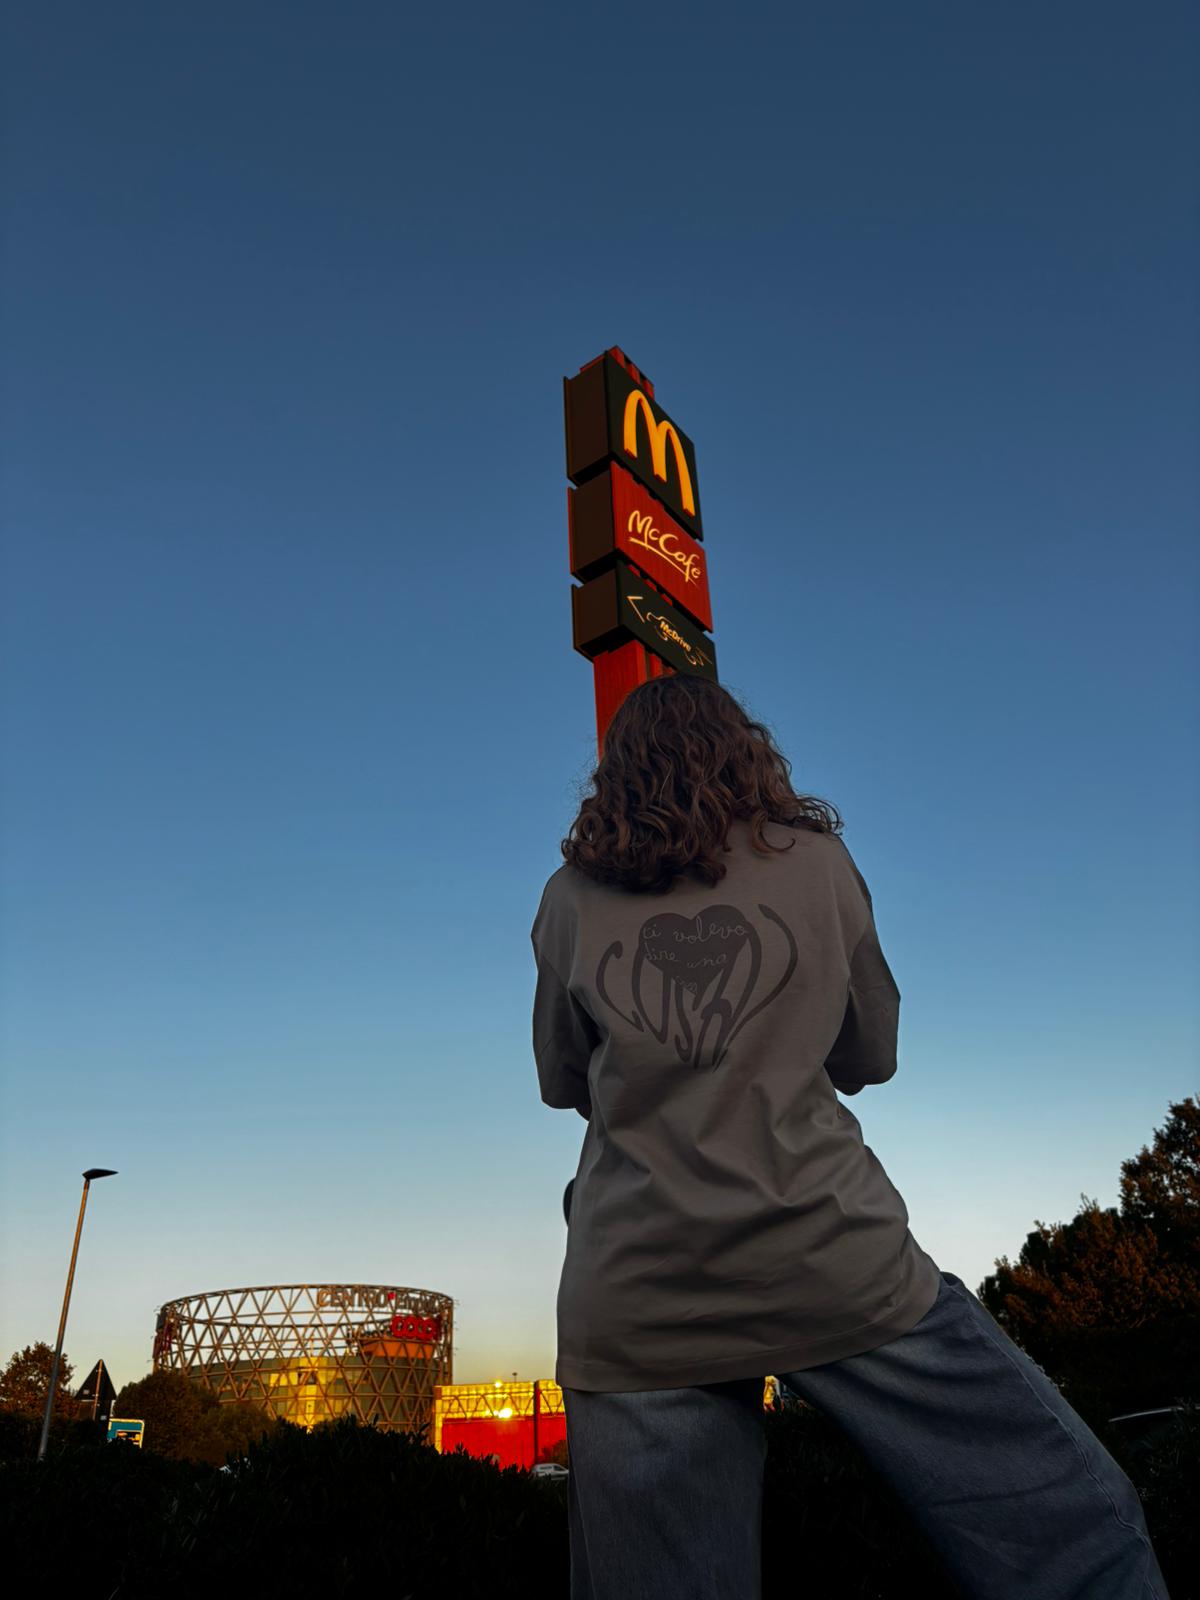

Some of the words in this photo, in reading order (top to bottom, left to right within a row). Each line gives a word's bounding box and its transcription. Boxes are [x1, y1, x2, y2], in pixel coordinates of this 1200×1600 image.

[660, 621, 691, 652] McDrive
[673, 915, 749, 944] volevo
[687, 953, 727, 968] una
